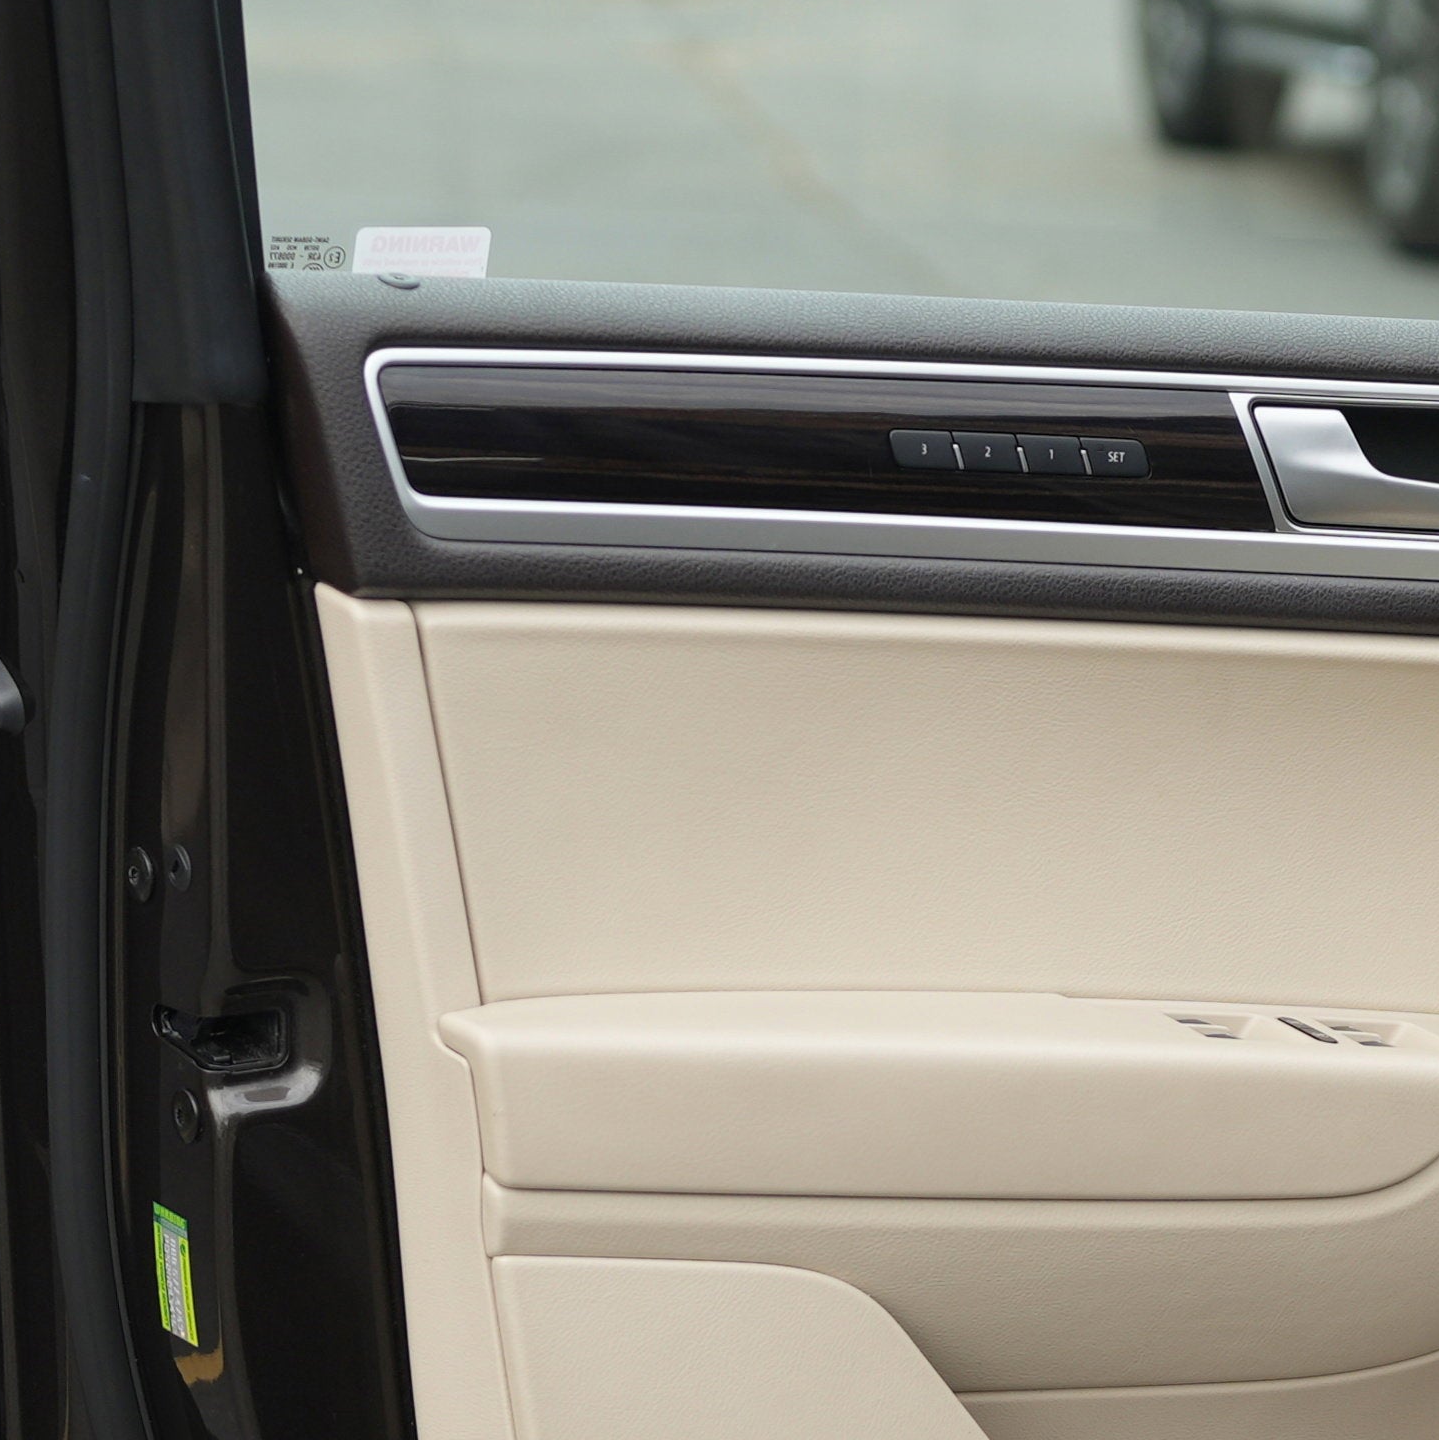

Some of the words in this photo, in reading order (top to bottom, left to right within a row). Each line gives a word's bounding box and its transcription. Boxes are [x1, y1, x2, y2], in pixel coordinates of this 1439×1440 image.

[921, 444, 928, 455] 3
[984, 446, 991, 458] 2
[1049, 449, 1054, 459] 1
[1108, 451, 1126, 463] SET
